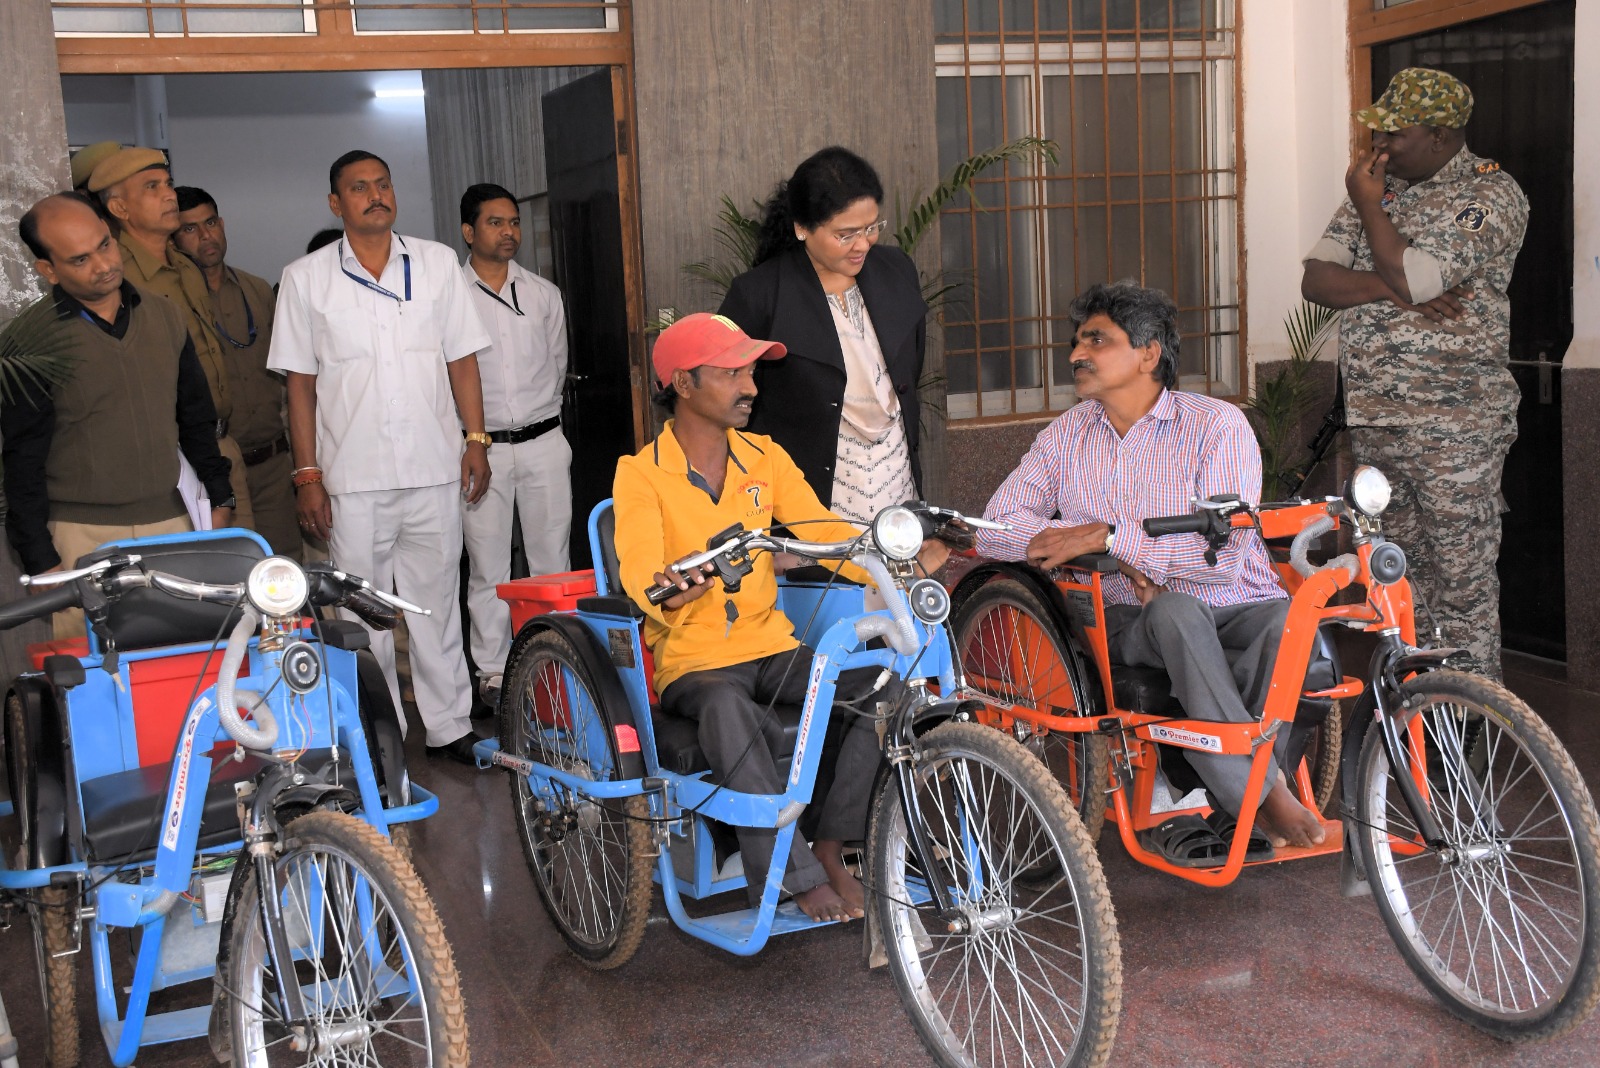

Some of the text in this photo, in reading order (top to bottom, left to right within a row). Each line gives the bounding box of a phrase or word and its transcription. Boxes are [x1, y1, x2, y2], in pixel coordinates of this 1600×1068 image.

[746, 486, 760, 508] 7
[800, 685, 817, 749] Premier
[1167, 730, 1200, 743] Premier
[174, 738, 192, 809] Premier
